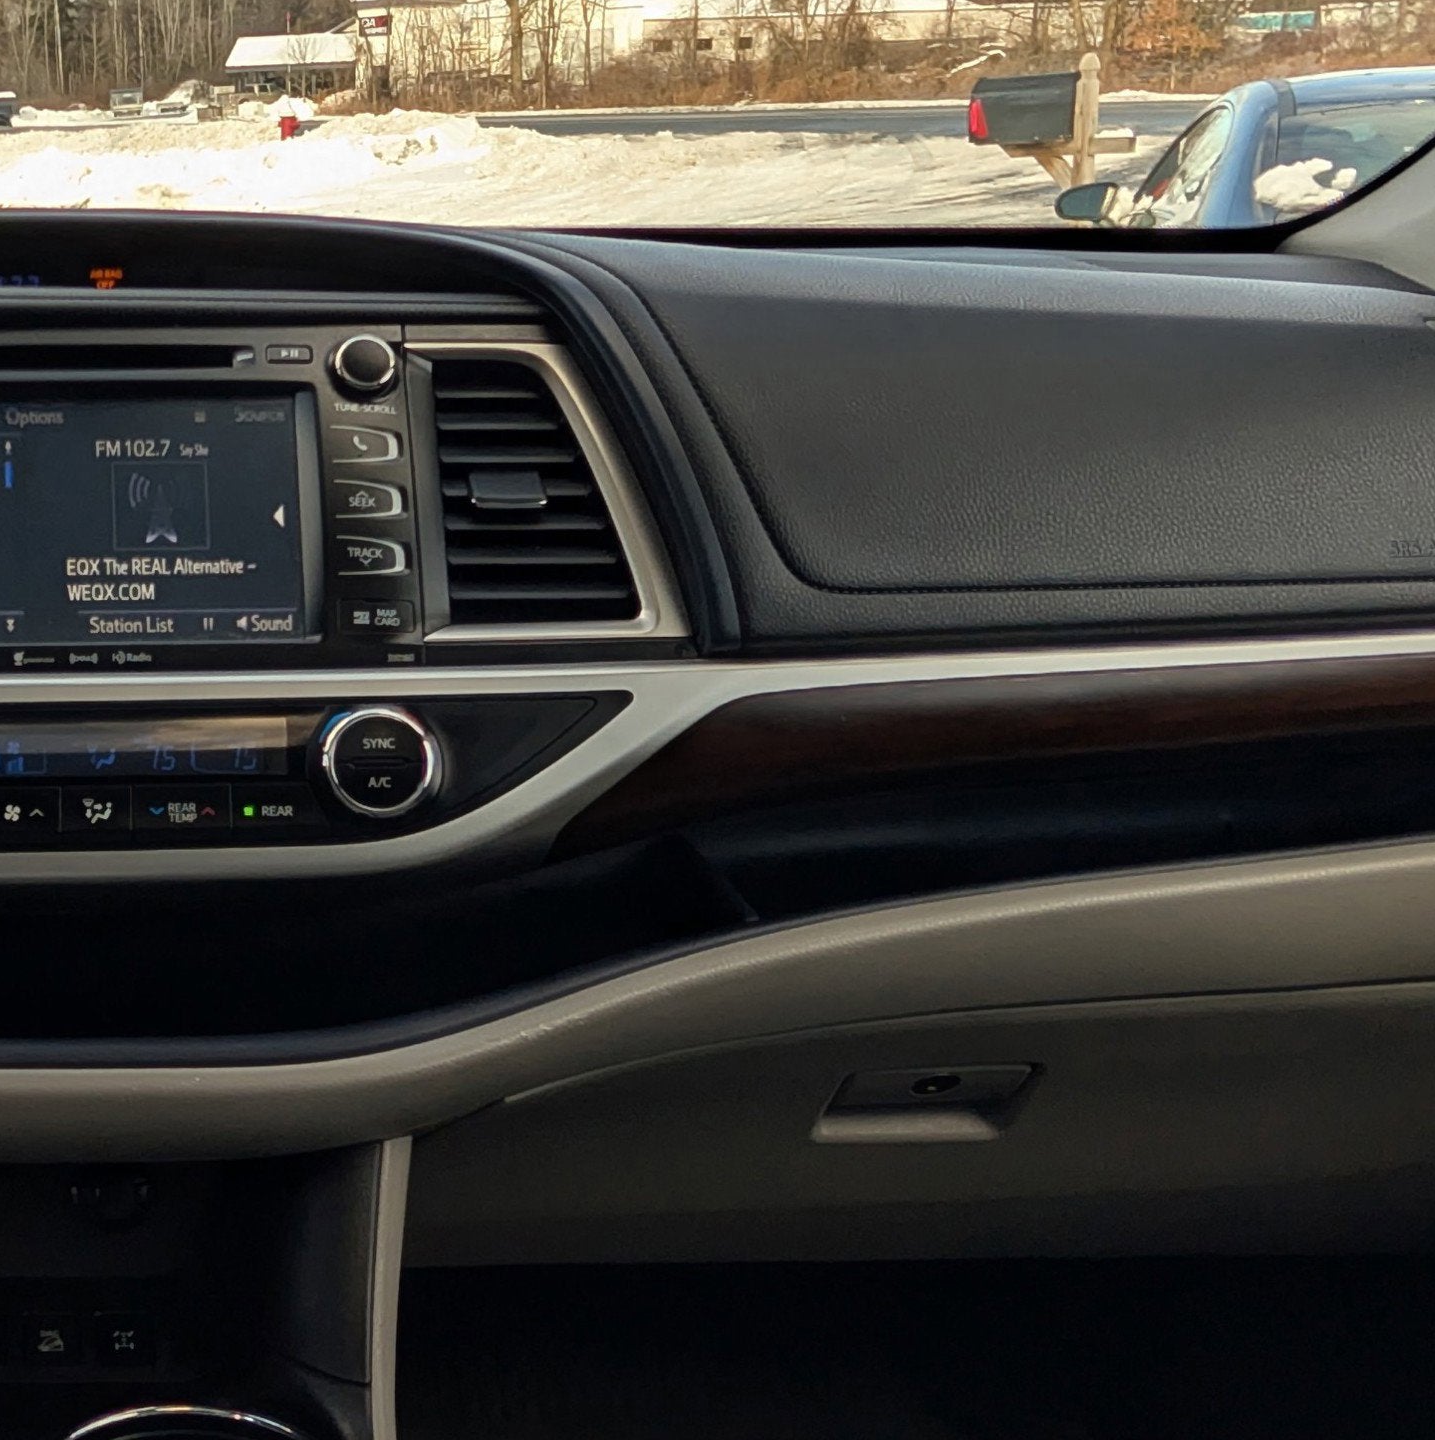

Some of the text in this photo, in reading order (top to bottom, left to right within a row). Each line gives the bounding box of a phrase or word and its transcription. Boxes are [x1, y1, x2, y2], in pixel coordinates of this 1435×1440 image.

[5, 409, 65, 429] Options
[95, 439, 121, 458] FM
[123, 439, 171, 458] 102.7
[348, 496, 376, 509] SEEK
[346, 546, 383, 559] TRACK
[66, 556, 244, 577] EQX The REAL Alternative
[67, 583, 155, 601] WEQX.COM
[89, 616, 174, 634] Station List
[250, 613, 293, 632] Sound
[362, 737, 396, 750] SYNC
[367, 776, 392, 789] A/C
[167, 802, 197, 813] REAR
[261, 805, 294, 817] REAR
[168, 812, 198, 824] TEMP
